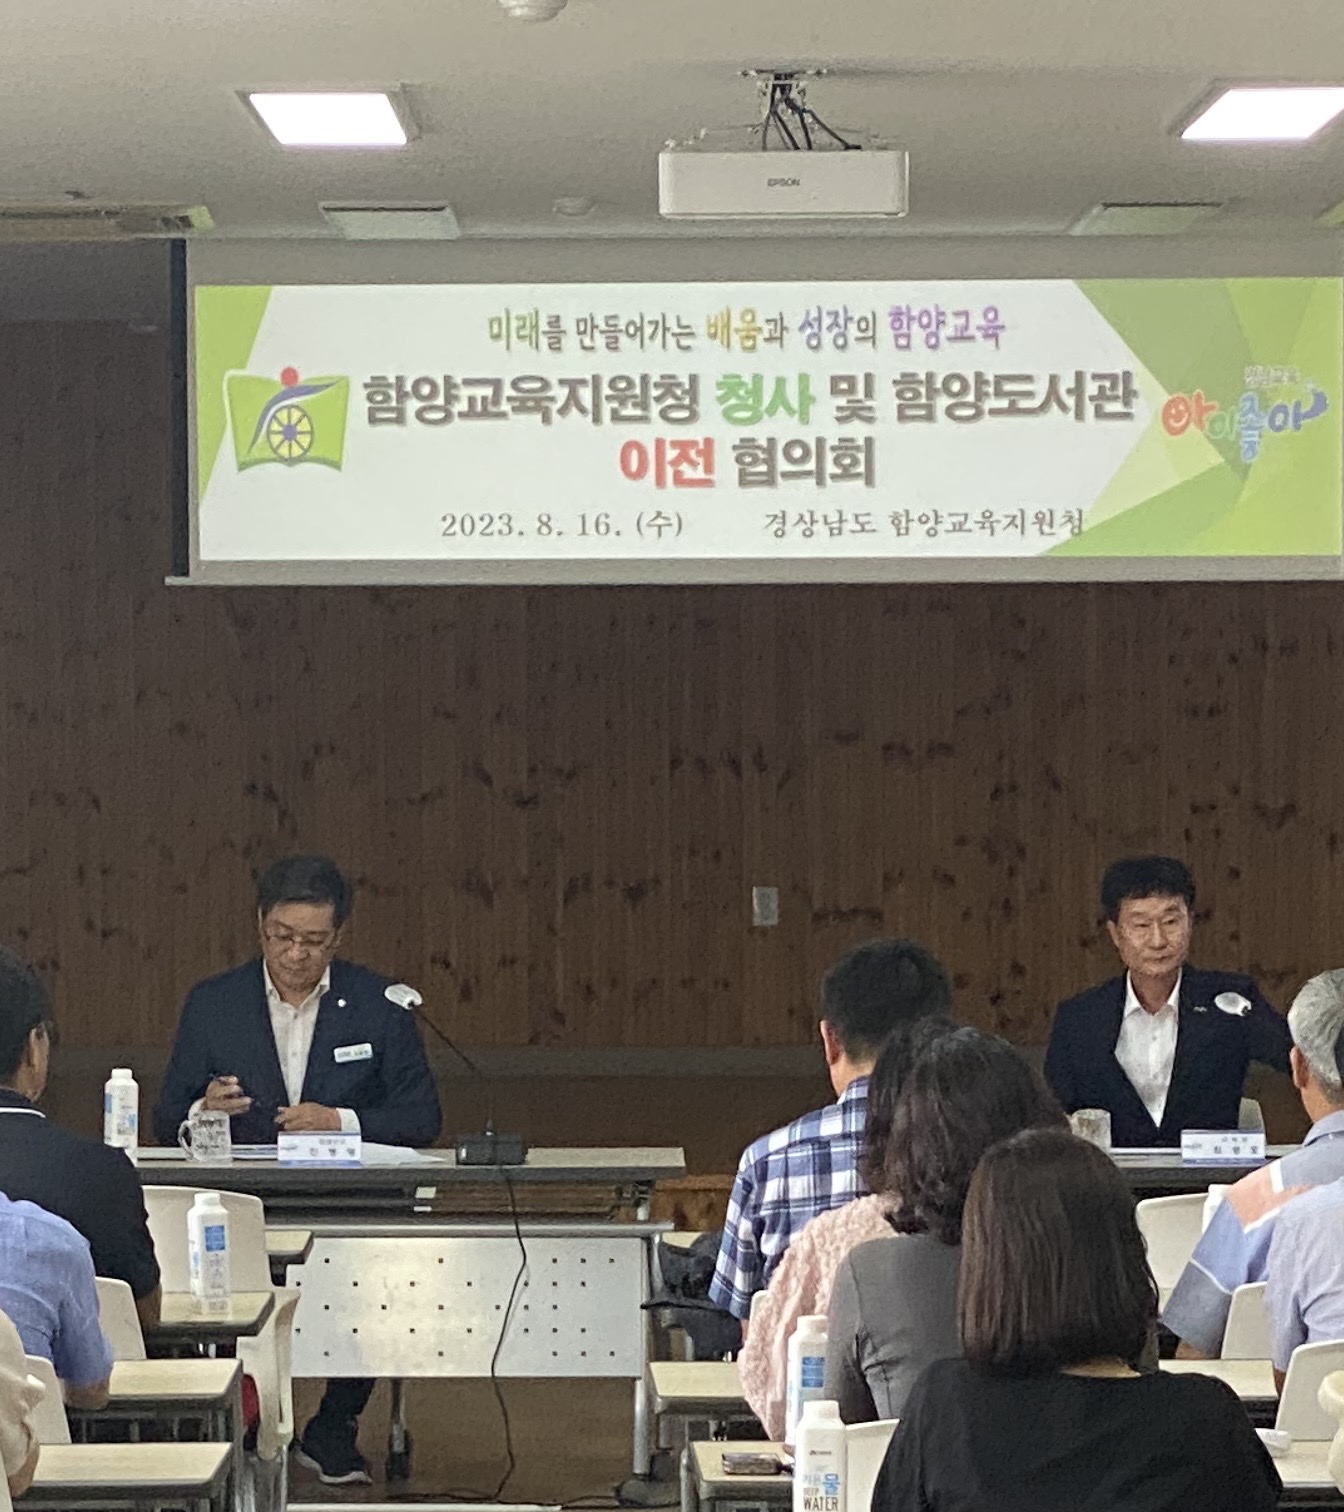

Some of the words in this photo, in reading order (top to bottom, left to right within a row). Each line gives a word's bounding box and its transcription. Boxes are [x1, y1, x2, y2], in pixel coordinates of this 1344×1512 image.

[767, 178, 800, 187] EPSON
[489, 307, 567, 353] 미래를
[575, 312, 696, 352] 만들어가는
[705, 305, 789, 353] 배움과
[798, 305, 877, 352] 성장의
[888, 304, 1006, 352] 함양교육
[362, 372, 701, 426] 함양교육지원청
[715, 371, 816, 426] 청사
[829, 371, 877, 425] 및
[892, 370, 1138, 423] 함양도서관
[619, 436, 716, 490] 이전
[731, 436, 876, 489] 협의회
[441, 513, 524, 537] 2023.
[537, 513, 563, 537] 8.
[577, 513, 621, 537] 16.
[636, 510, 683, 538] (수)
[763, 509, 877, 538] 경상남도
[888, 508, 1084, 538] 함양교육지원청
[803, 1496, 839, 1511] WATER
